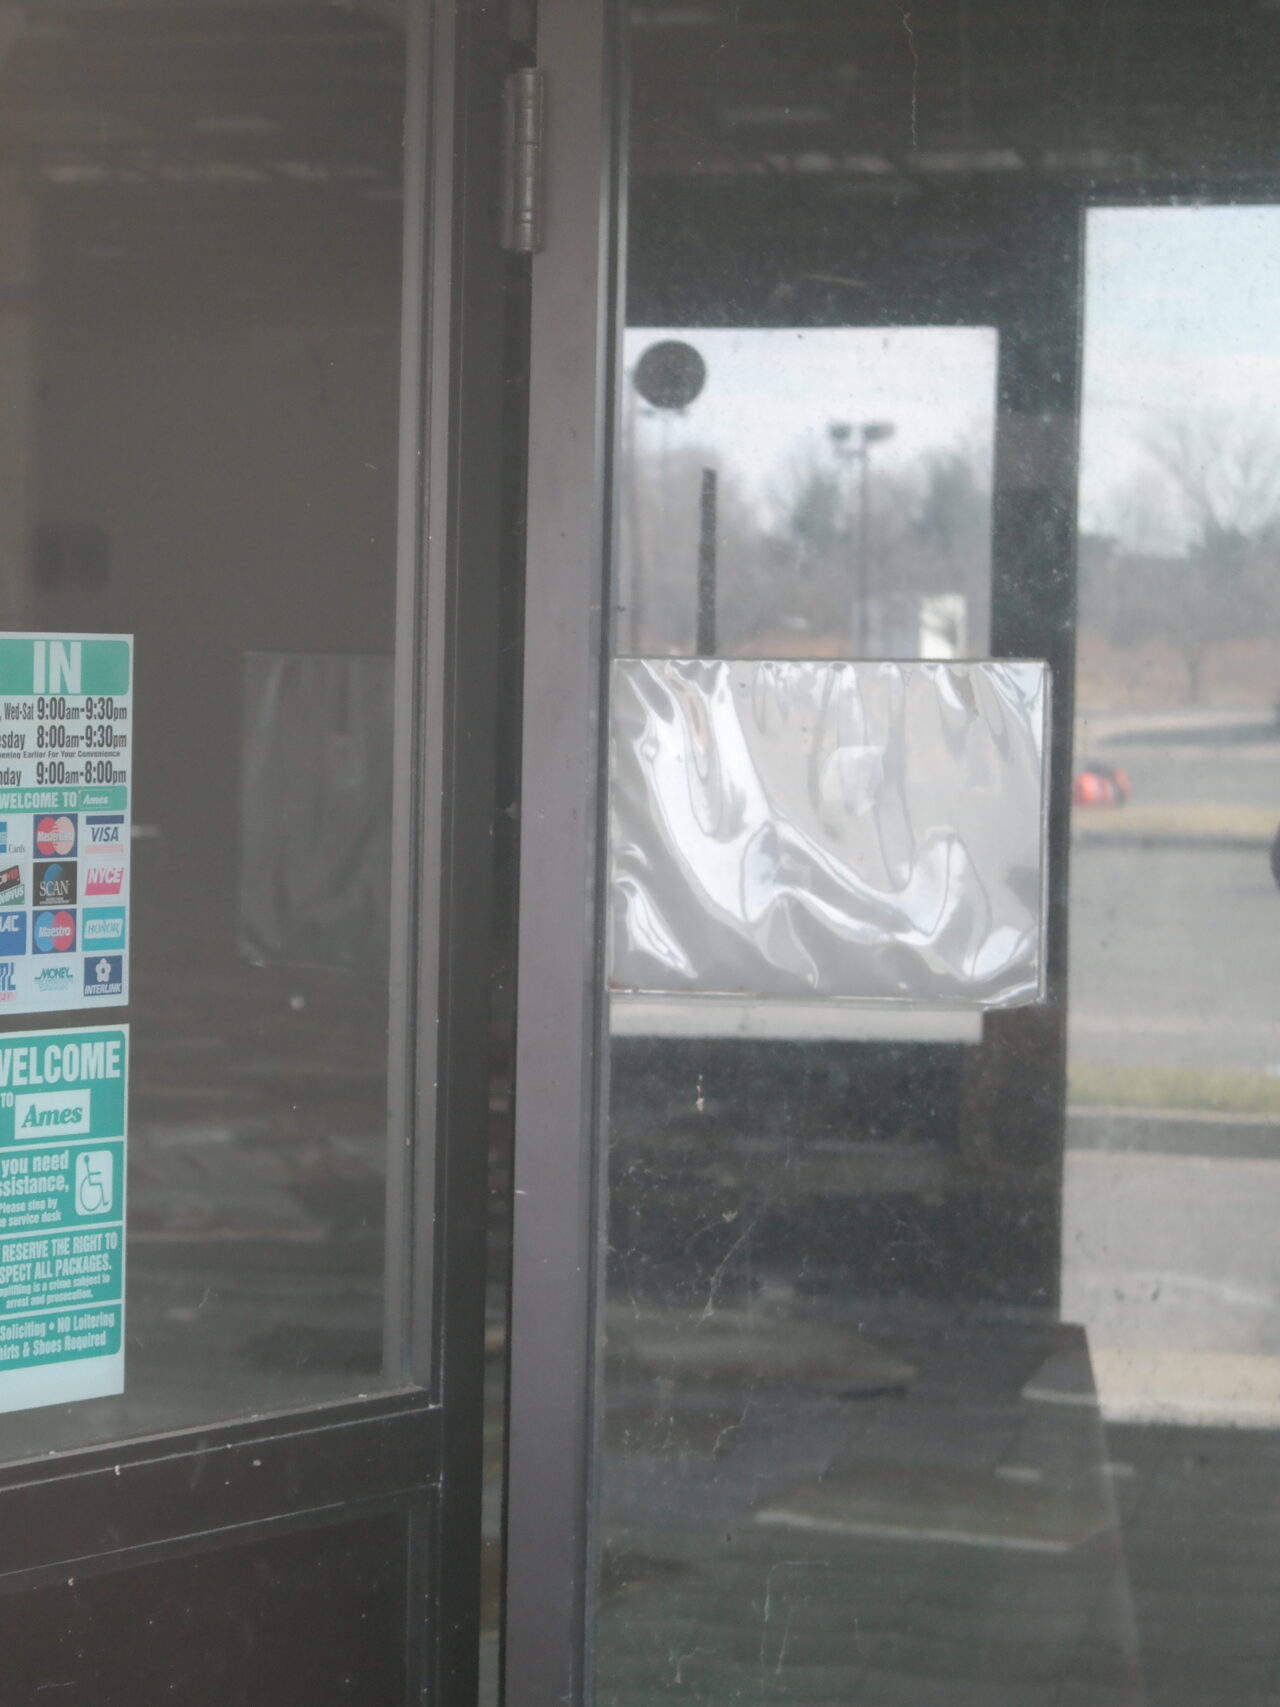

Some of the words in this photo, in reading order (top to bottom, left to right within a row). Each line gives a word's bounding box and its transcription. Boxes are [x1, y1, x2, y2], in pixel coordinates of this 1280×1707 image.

[33, 640, 82, 694] IN
[4, 702, 35, 721] Wed-Sat
[37, 697, 127, 721] 9:00am-9:30pm
[36, 725, 127, 749] 8:00am-9:30pm
[23, 751, 46, 759] Earlier
[61, 750, 76, 758] Your
[77, 750, 120, 758] Convenience
[36, 760, 127, 785] 9:00am-8:00pm
[62, 791, 77, 807] TO
[91, 826, 119, 842] VISA
[88, 867, 123, 885] NYCE
[39, 880, 69, 897] SCAN
[38, 926, 71, 937] Maestro
[84, 983, 122, 995] INTERLINK
[0, 1092, 14, 1108] TO
[20, 1104, 83, 1128] Ames
[2, 1157, 28, 1179] you
[33, 1150, 69, 1173] need
[28, 1199, 47, 1212] stop
[48, 1197, 58, 1209] by
[8, 1213, 39, 1227] service
[41, 1210, 61, 1223] desk
[2, 1240, 49, 1263] RESERVE
[51, 1237, 70, 1257] THE
[72, 1233, 102, 1254] RIGHT
[105, 1232, 118, 1250] TO
[34, 1260, 53, 1279] ALL
[55, 1253, 112, 1277] PACKAGES.
[33, 1281, 41, 1292] is
[49, 1278, 71, 1291] crime
[102, 1273, 111, 1284] to
[31, 1294, 45, 1306] and
[0, 1321, 46, 1342] Soliciting
[57, 1317, 71, 1334] NO
[73, 1312, 115, 1330] Loitering
[22, 1343, 30, 1358] &
[33, 1338, 62, 1356] Shoes
[64, 1331, 106, 1351] Required
